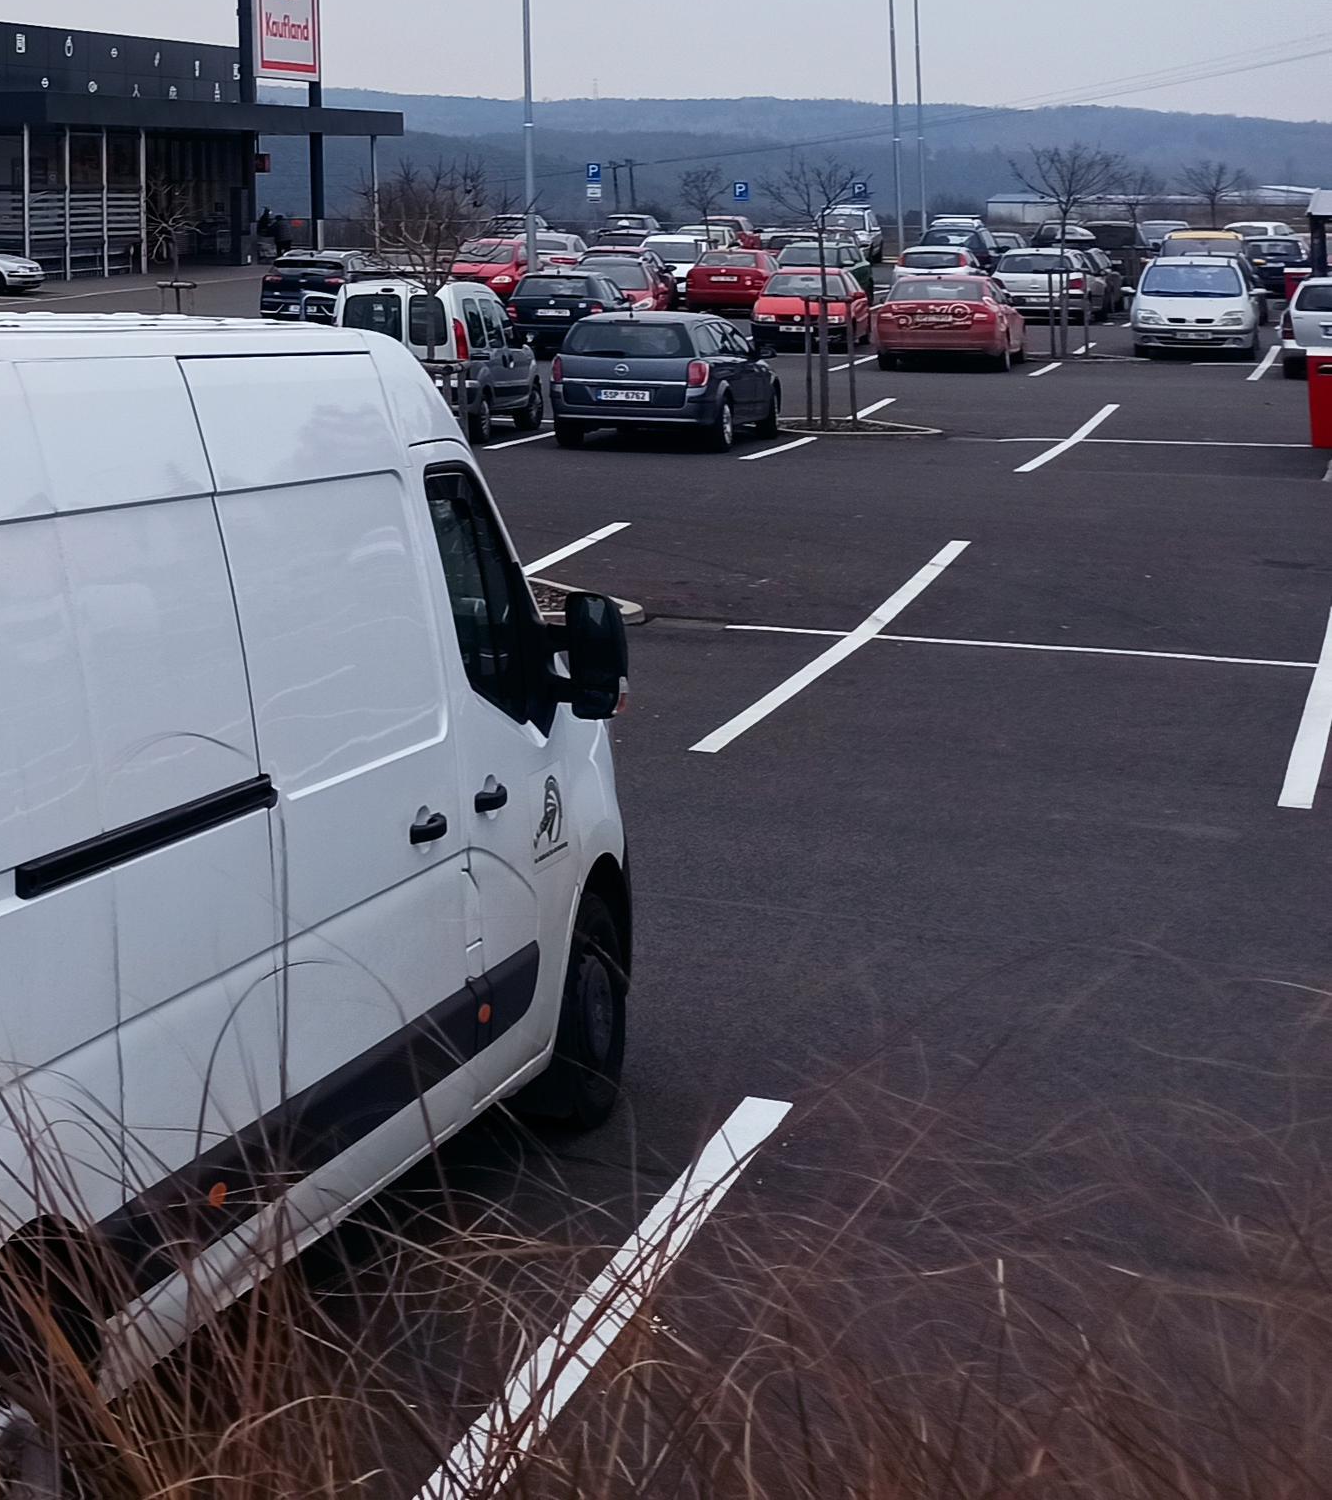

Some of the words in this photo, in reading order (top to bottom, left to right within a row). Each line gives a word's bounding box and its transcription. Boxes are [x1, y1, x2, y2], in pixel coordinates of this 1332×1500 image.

[265, 11, 309, 41] Kaufland
[588, 164, 598, 176] P
[735, 183, 745, 196] P
[854, 183, 865, 194] P
